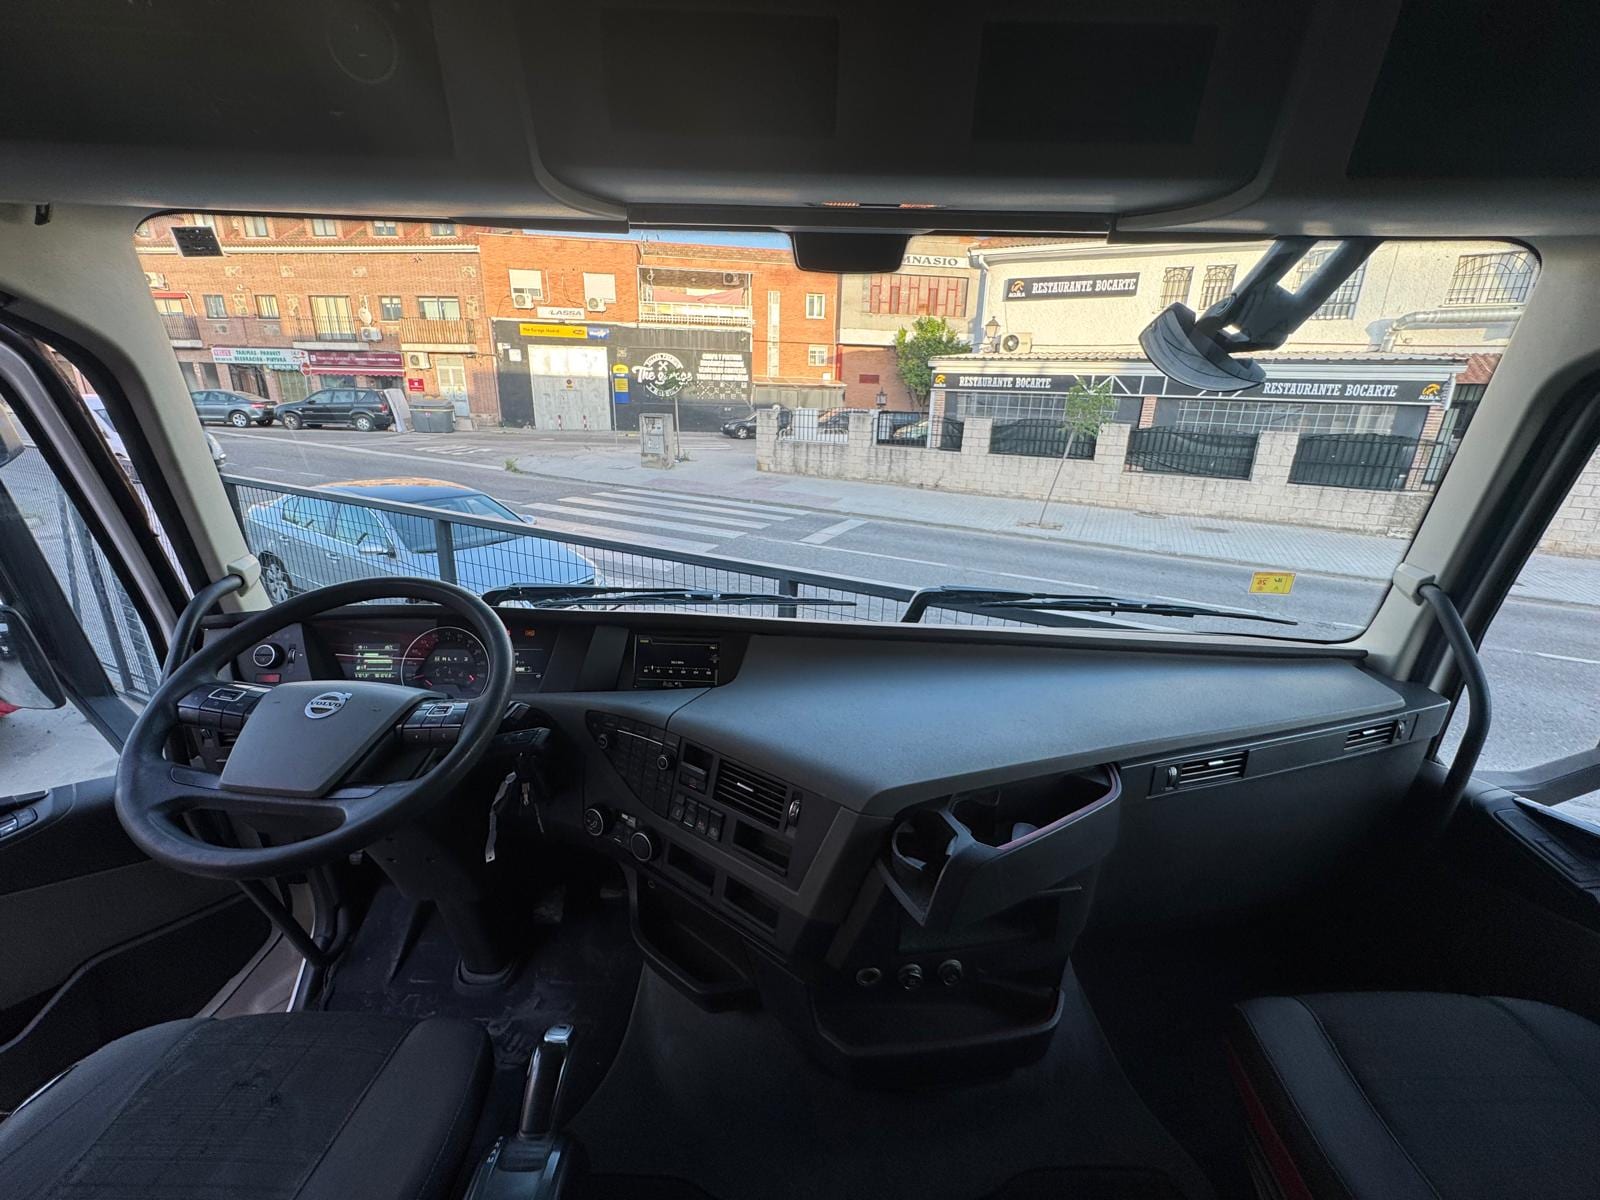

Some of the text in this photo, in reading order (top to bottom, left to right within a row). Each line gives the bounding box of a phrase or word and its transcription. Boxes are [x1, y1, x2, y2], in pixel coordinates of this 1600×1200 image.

[902, 255, 958, 266] MNASIO
[1032, 278, 1137, 294] RESTAURANTE BOCARTE
[631, 365, 656, 383] The
[959, 376, 1014, 387] RESTAURANTE
[1015, 377, 1052, 389] BOCARTE
[1262, 382, 1398, 397] RESTAURANTE BOCARTE
[311, 700, 342, 708] VOLVO
